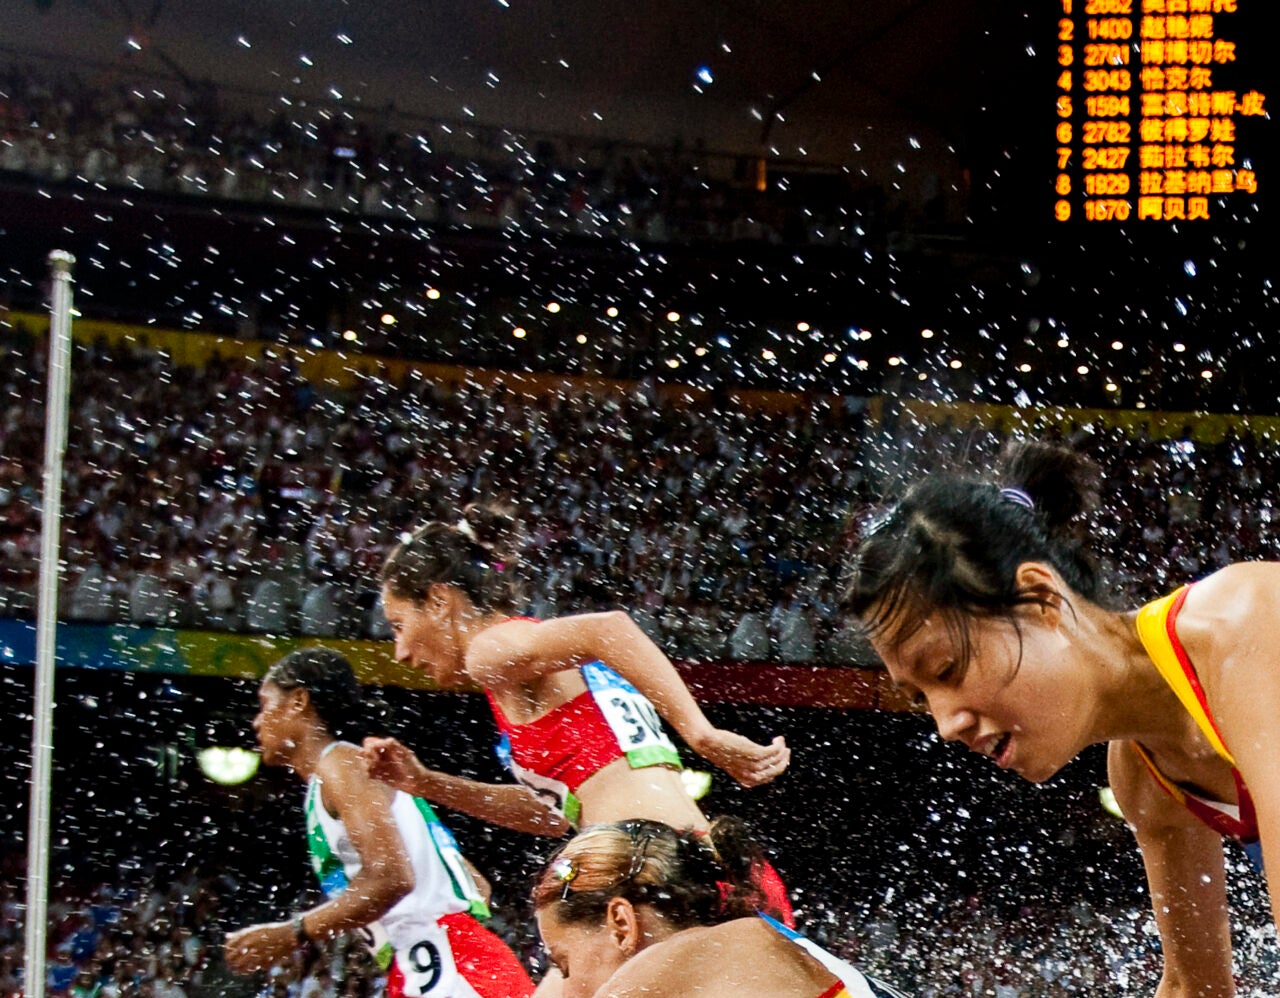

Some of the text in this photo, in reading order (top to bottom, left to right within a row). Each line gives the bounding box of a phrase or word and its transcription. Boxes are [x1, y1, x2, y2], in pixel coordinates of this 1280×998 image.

[1058, 18, 1074, 40] 2
[1087, 18, 1132, 40] 1400
[1058, 44, 1074, 66] 3
[1057, 70, 1072, 91] 4
[1083, 69, 1131, 91] 3043
[1057, 95, 1073, 118] 5
[1056, 121, 1072, 144] 6
[1056, 147, 1072, 169] 7
[1082, 146, 1131, 169] 2427
[1055, 173, 1071, 195] 8
[1083, 172, 1131, 195] 1929
[1055, 199, 1071, 221] 9
[1138, 196, 1210, 221] 阿贝贝
[409, 940, 442, 995] 9
